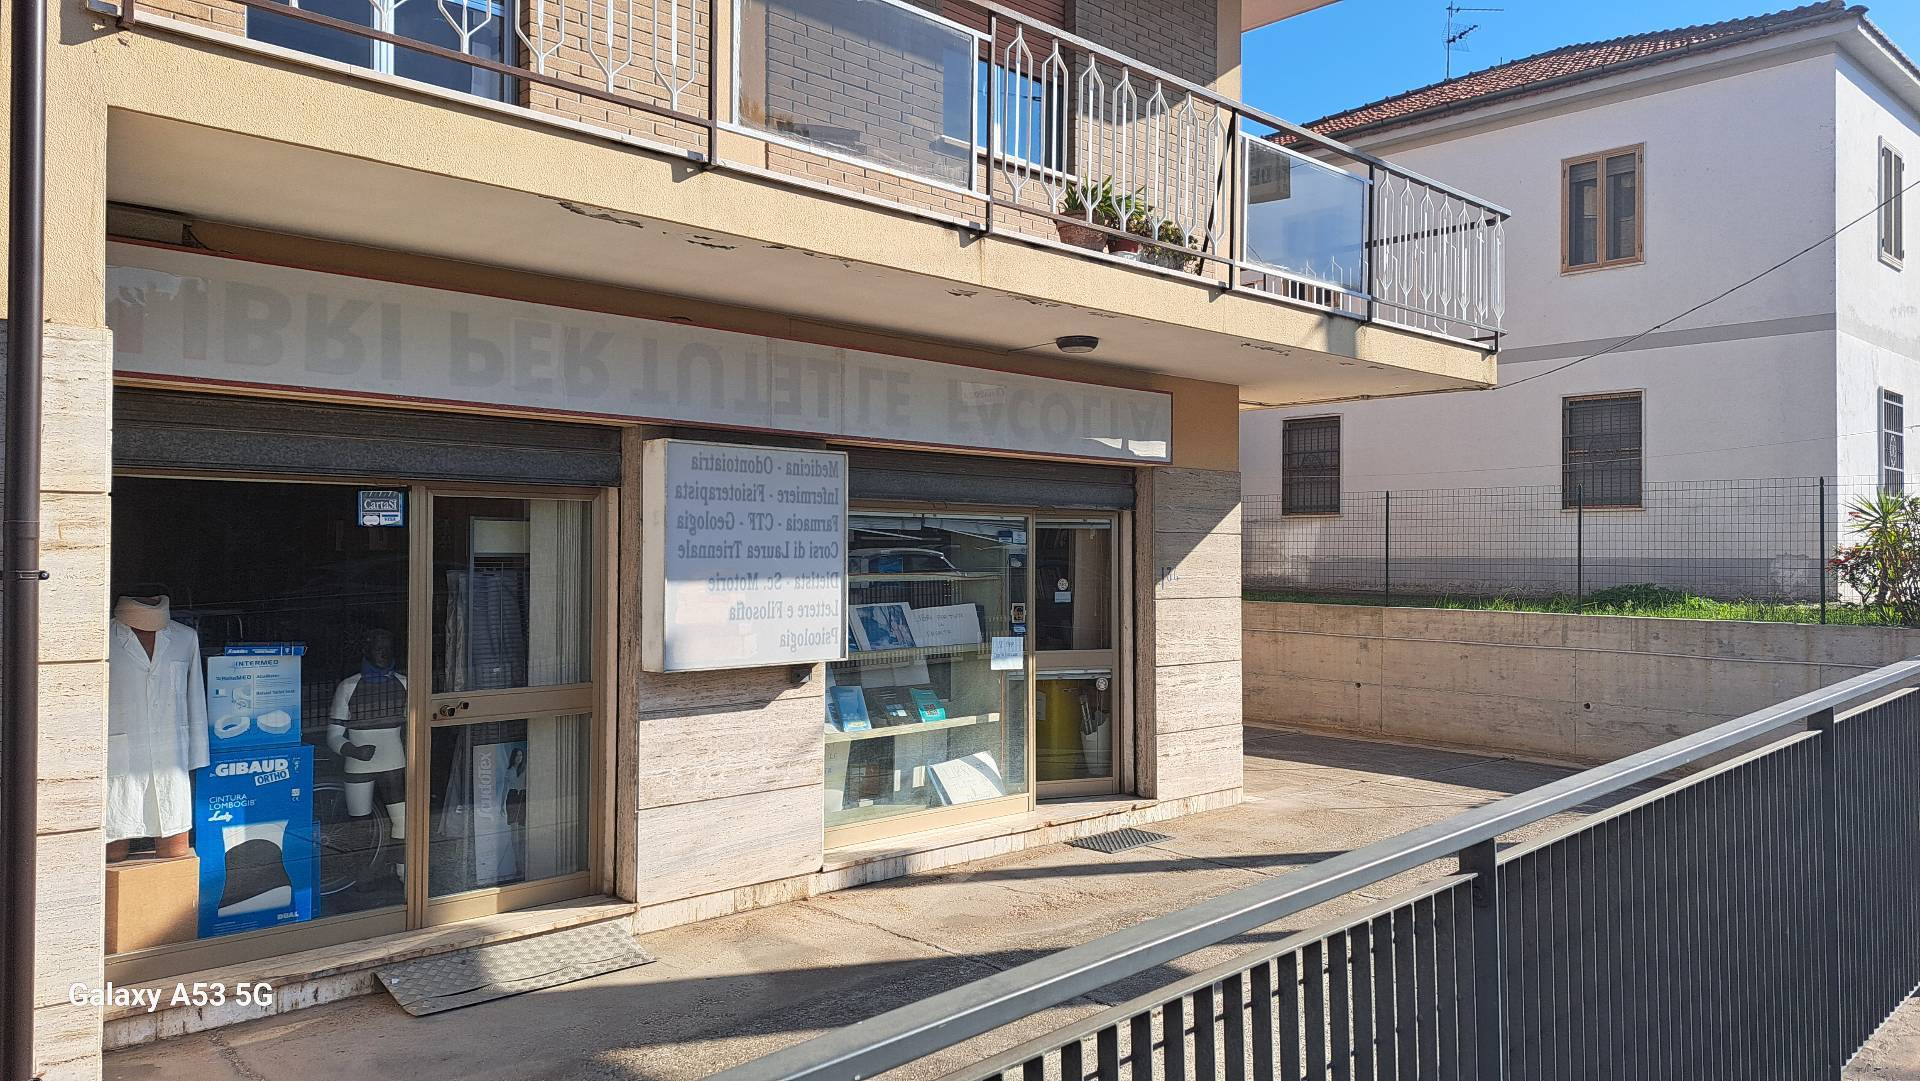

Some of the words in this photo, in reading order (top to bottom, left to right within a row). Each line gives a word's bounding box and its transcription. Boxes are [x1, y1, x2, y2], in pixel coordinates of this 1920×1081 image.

[235, 659, 279, 667] INTERMED
[215, 759, 289, 777] GIBAUD
[256, 770, 287, 784] ORTHO
[208, 793, 248, 804] CINTURA
